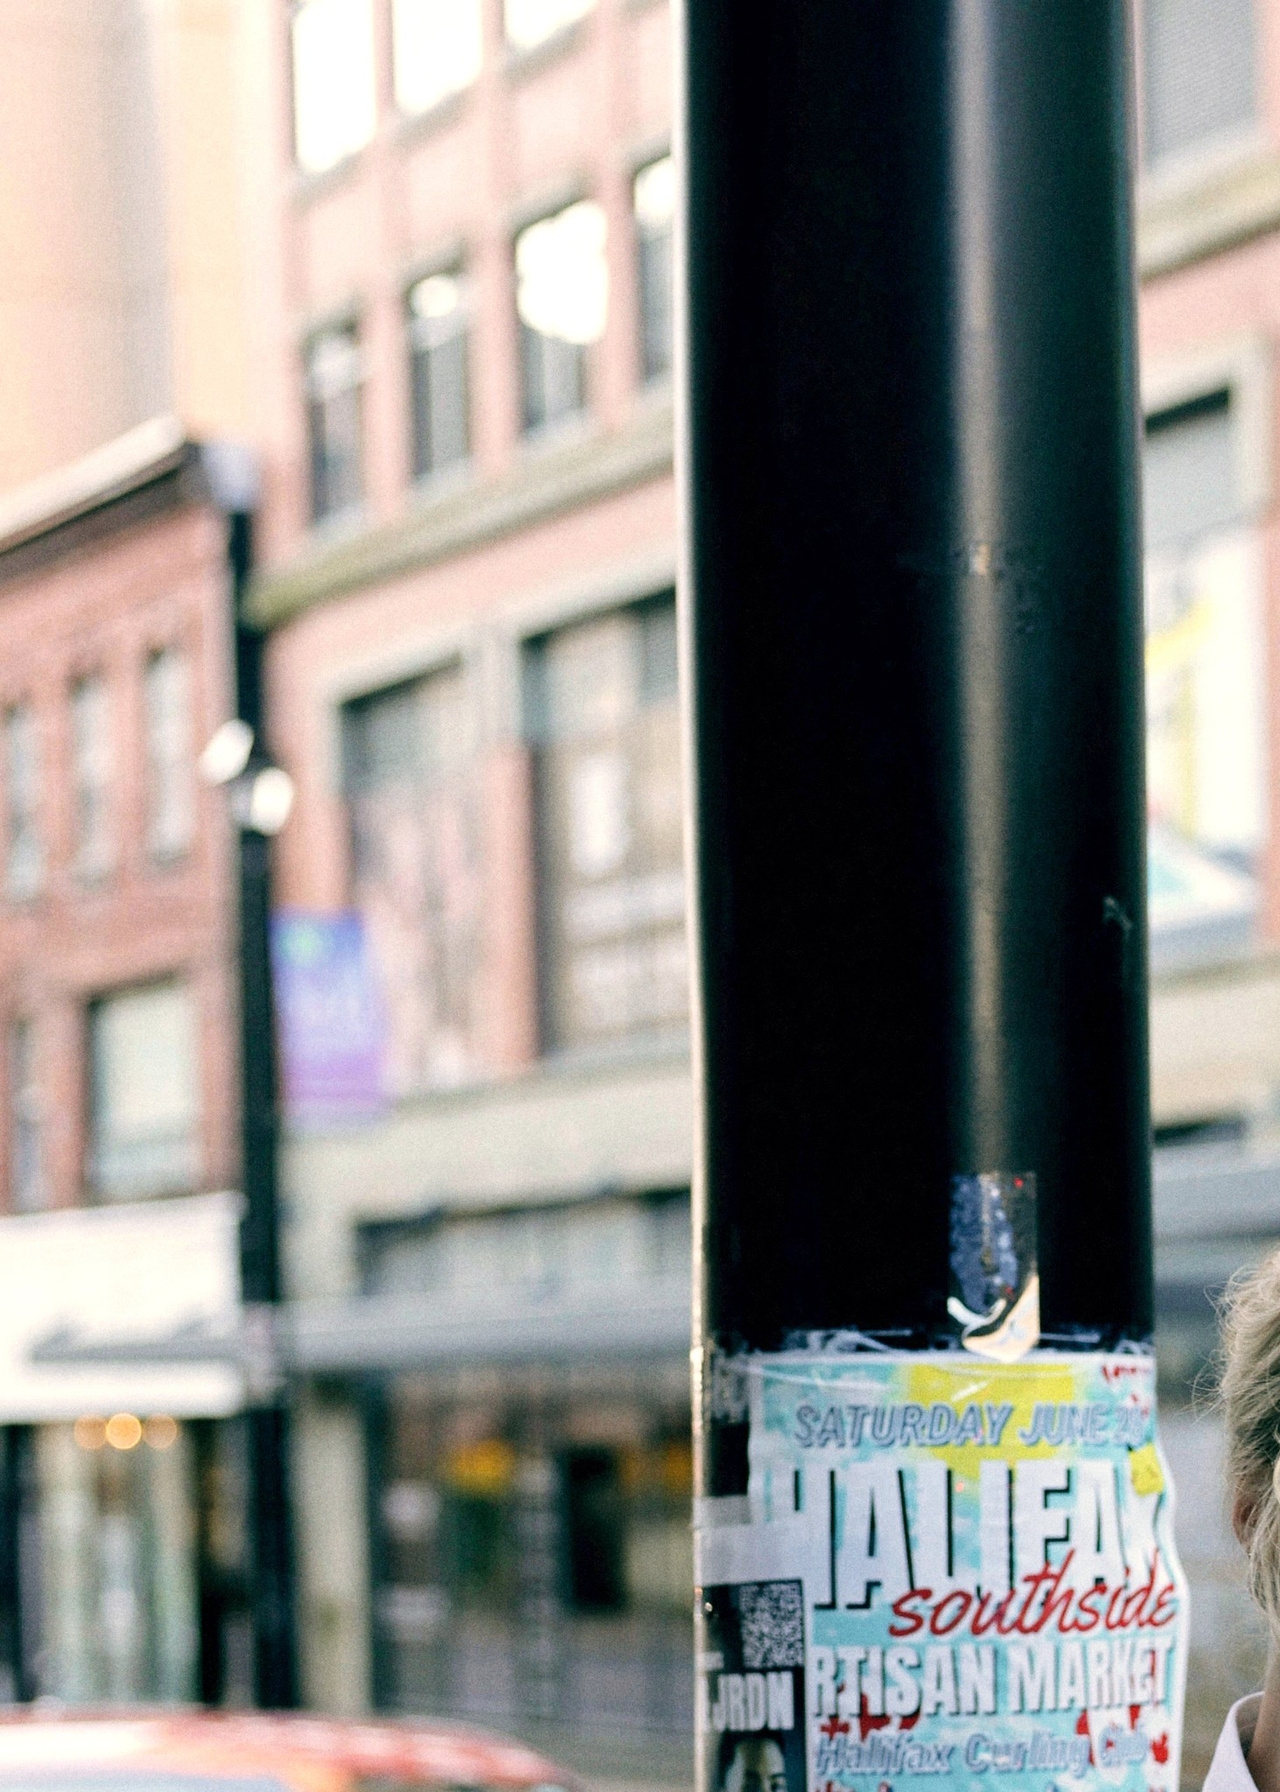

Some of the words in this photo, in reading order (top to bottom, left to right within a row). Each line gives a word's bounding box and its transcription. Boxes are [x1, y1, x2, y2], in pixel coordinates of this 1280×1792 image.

[795, 1402, 1015, 1448] SATURDAY
[1017, 1402, 1110, 1448] JUNE
[768, 1459, 1176, 1611] HALIFAX
[889, 1549, 1176, 1637] southside
[813, 1643, 1000, 1719] RTISAN
[1006, 1636, 1173, 1714] MARKET
[813, 1730, 954, 1776] Halifax
[962, 1732, 1092, 1780] Curling
